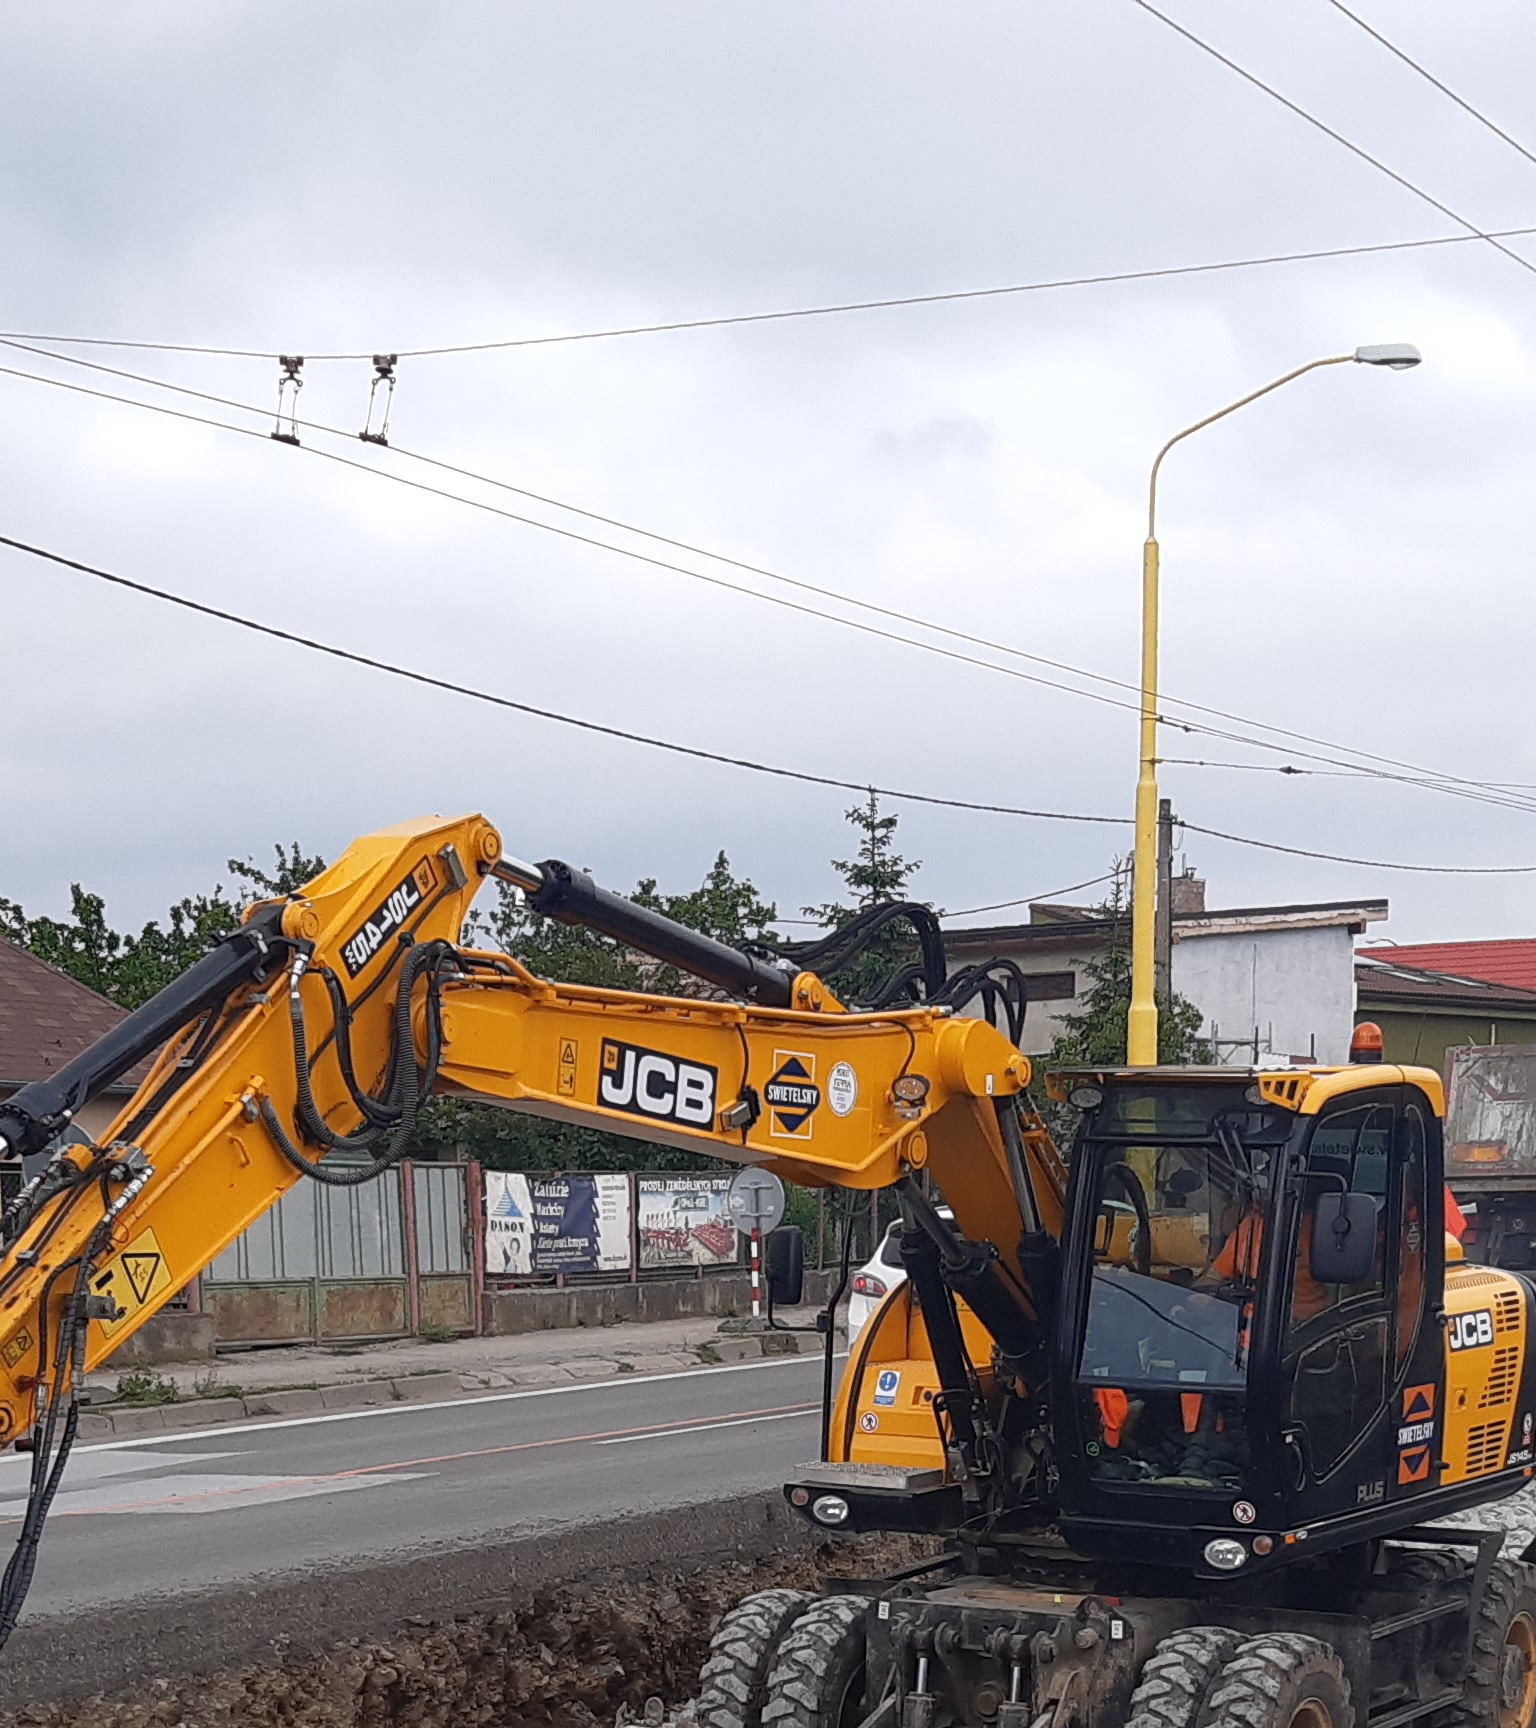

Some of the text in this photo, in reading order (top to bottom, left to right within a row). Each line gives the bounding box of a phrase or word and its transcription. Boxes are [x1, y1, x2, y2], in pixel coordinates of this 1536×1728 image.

[601, 1049, 714, 1124] JCB
[767, 1084, 818, 1105] SWIETELSKY
[490, 1219, 526, 1234] DASON
[1449, 1311, 1493, 1349] JCB
[1357, 1480, 1385, 1503] PLUS
